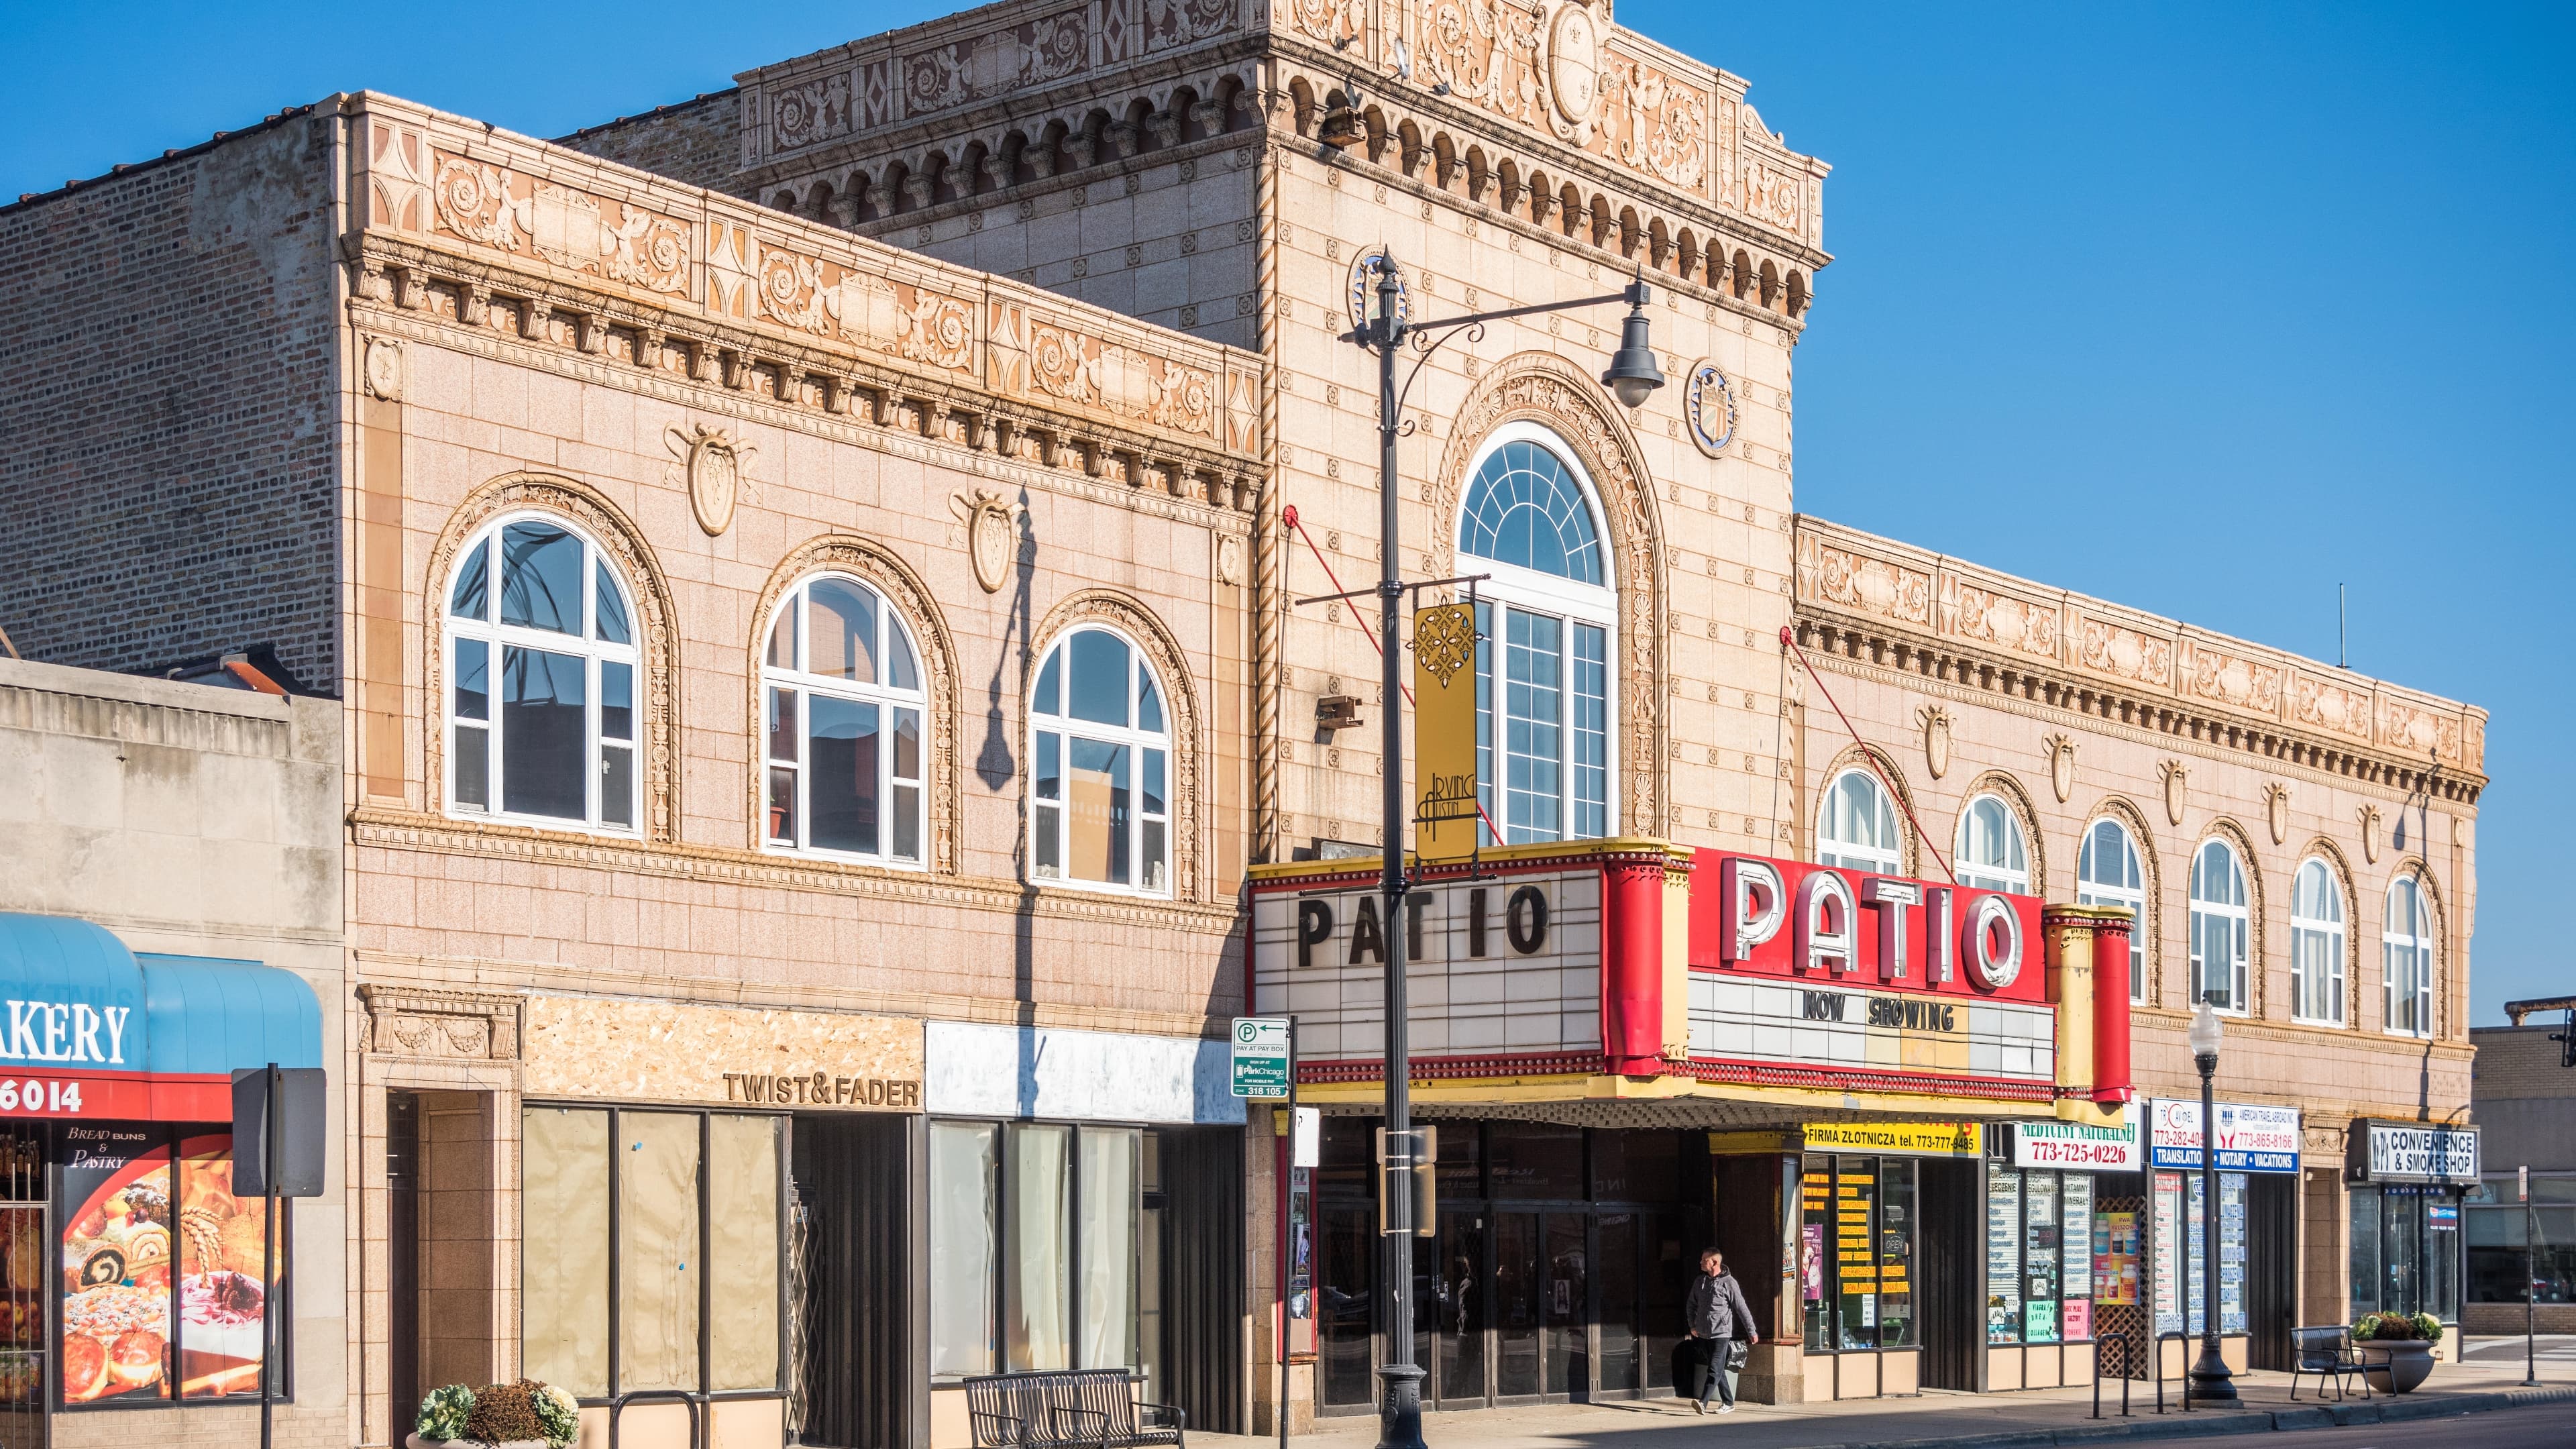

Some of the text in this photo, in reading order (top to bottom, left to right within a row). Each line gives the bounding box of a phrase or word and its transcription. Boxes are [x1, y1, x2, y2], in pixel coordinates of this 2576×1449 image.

[1432, 773, 1474, 800] IRVING
[1297, 884, 1548, 968] PATIO
[1721, 857, 2023, 989] PATIO
[1803, 990, 1954, 1032] NOW SHOWING
[0, 999, 130, 1064] KERY
[1244, 1067, 1284, 1077] ParkChicago
[0, 1079, 82, 1112] 6014
[722, 1071, 919, 1106] TWIST&FADER
[1248, 1087, 1263, 1095] 318
[1266, 1087, 1281, 1095] 105
[2239, 1109, 2258, 1121] AMERICAN
[2259, 1110, 2271, 1122] TRAVEL
[68, 1127, 110, 1140] BREAD
[1809, 1128, 1974, 1150] FIRMA ZŁOTNICZA tel. 773-777-9485
[2155, 1130, 2205, 1146] 773-282-405
[2239, 1132, 2292, 1148] 773-865-8166
[2392, 1132, 2473, 1153] CONVENIENCE
[99, 1143, 107, 1152] &
[2032, 1142, 2126, 1164] 773-725-0226
[70, 1149, 126, 1169] PASTRY
[2157, 1148, 2292, 1169] TRANSLATIO NOTARY VACATIONS
[2395, 1152, 2470, 1173] & SMOKE SHOP
[1886, 1240, 1904, 1249] OPEN
